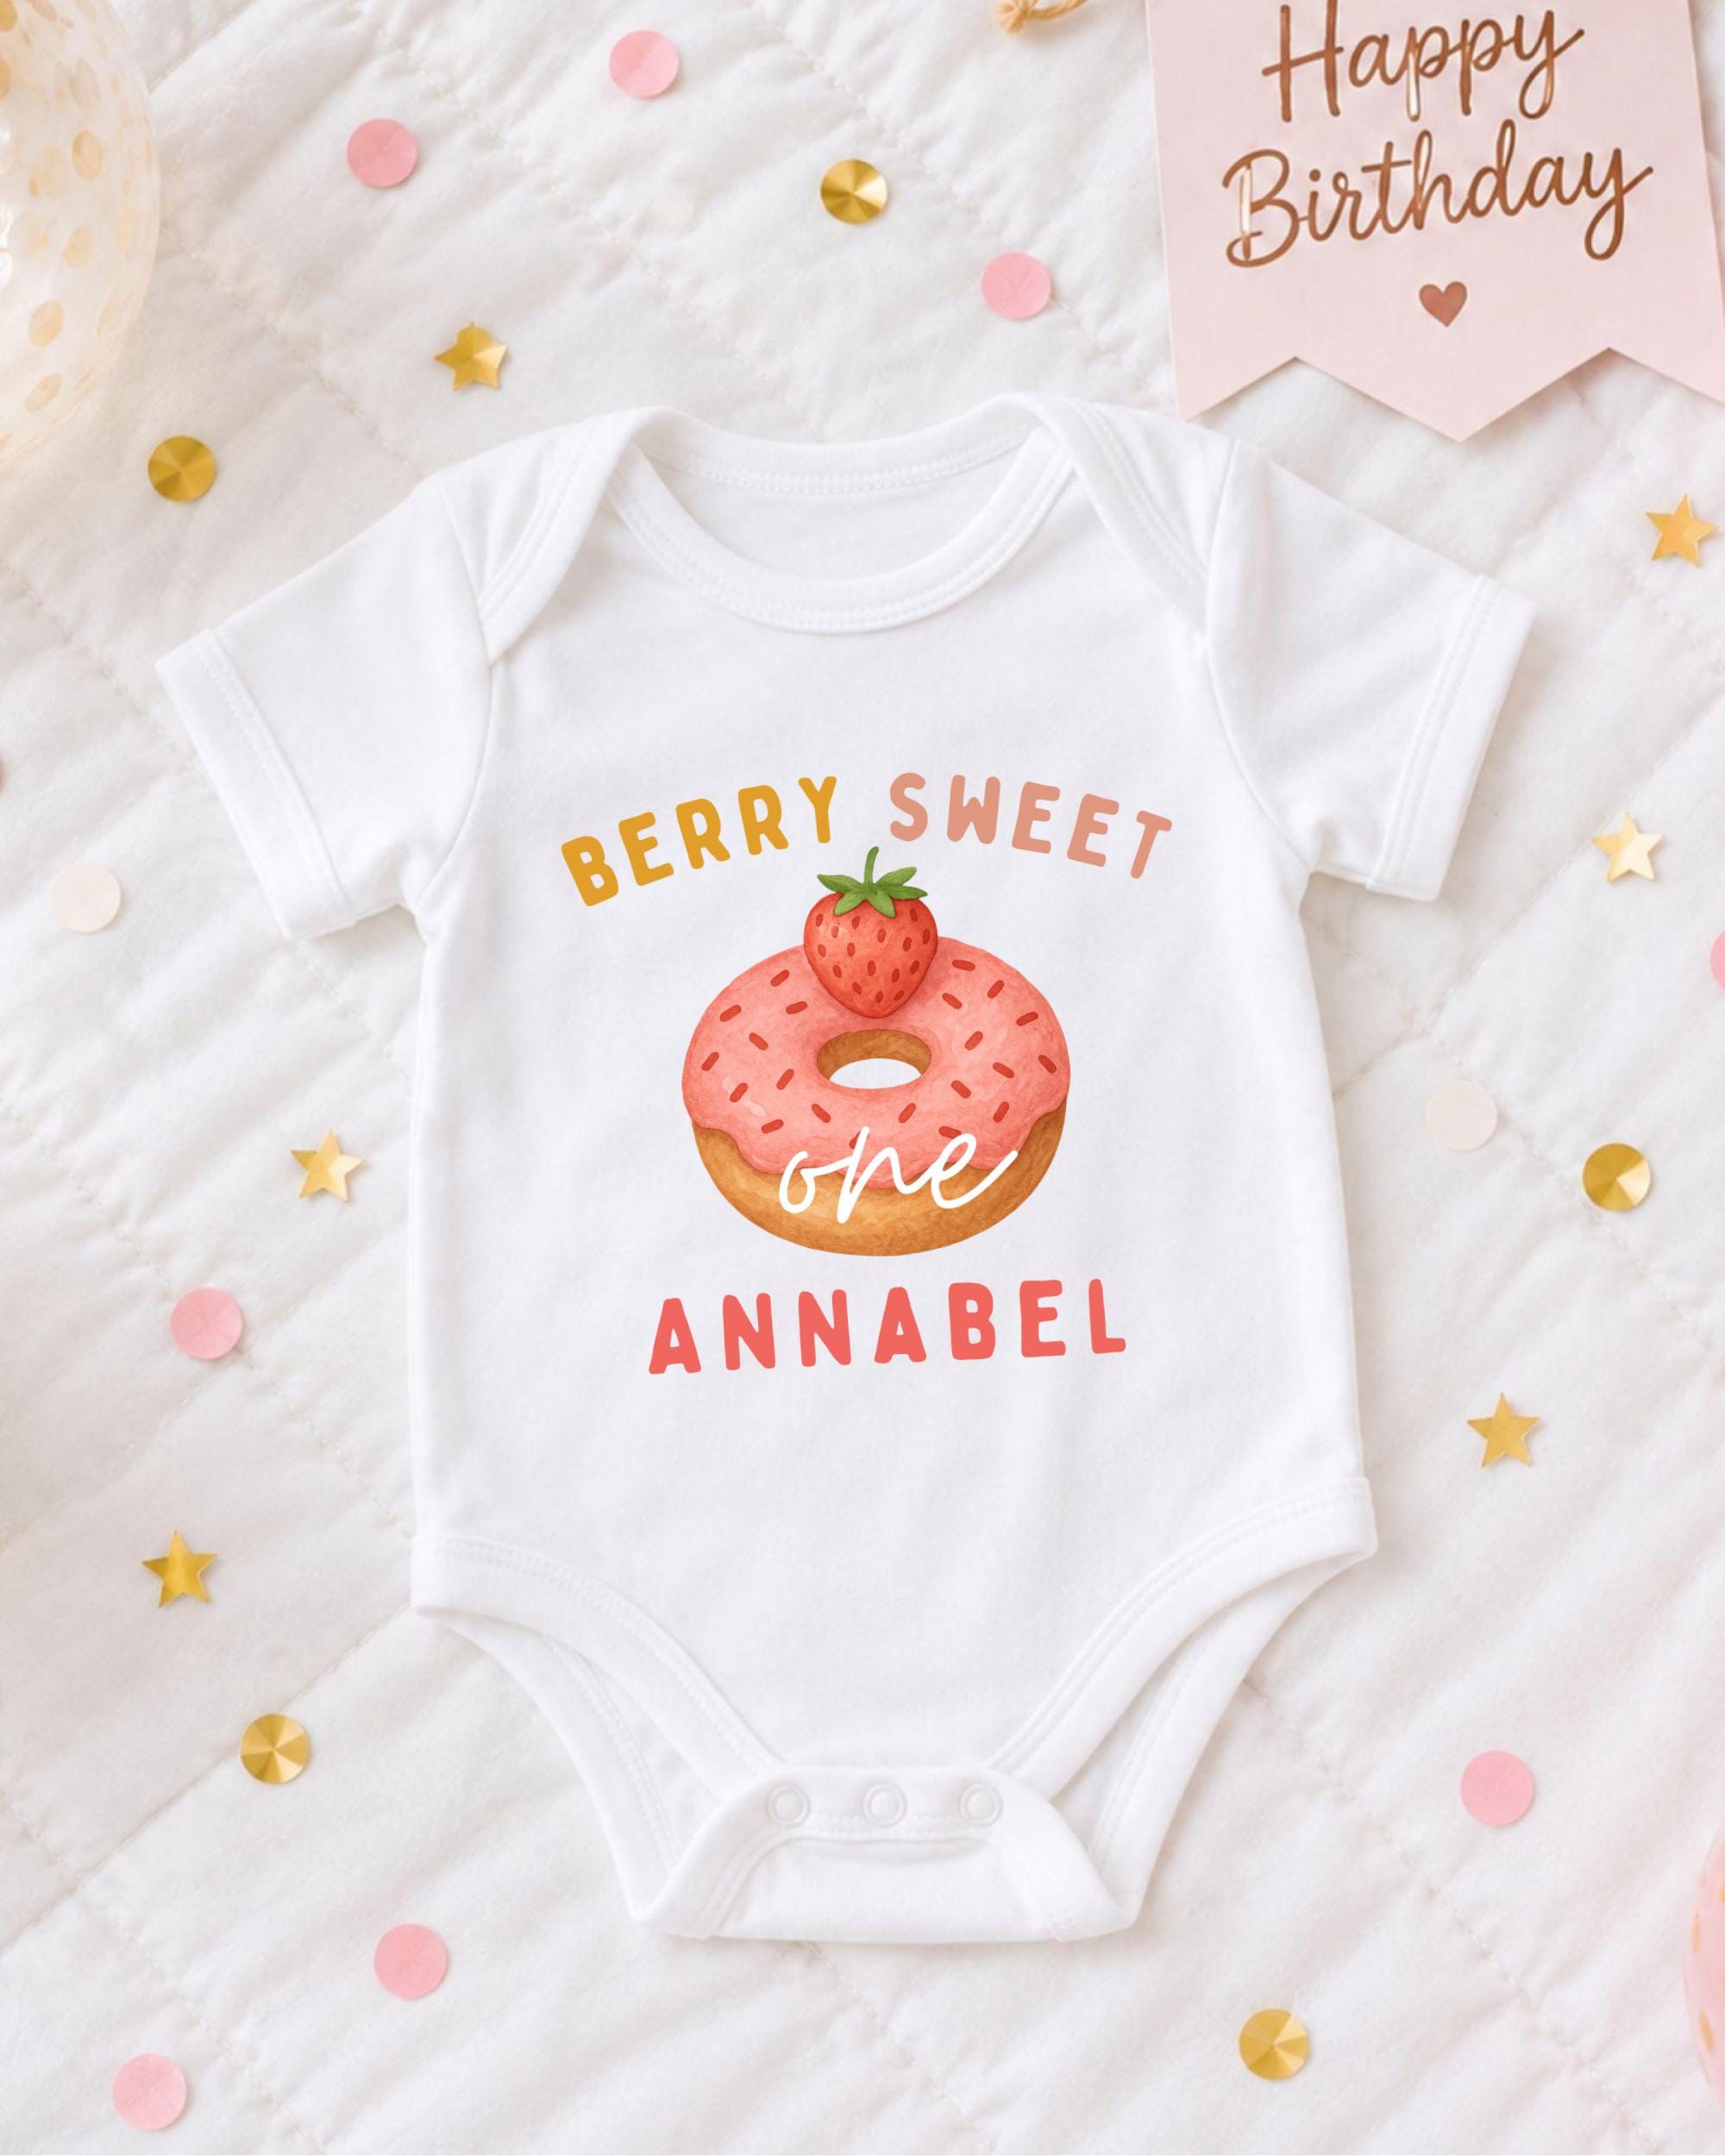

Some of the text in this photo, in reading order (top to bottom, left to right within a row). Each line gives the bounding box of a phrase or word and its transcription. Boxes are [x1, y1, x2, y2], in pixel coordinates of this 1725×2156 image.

[1262, 0, 1584, 122] Happy
[1222, 118, 1653, 268] Birthday
[560, 772, 1173, 907] BERRY SWEET
[779, 1126, 1019, 1224] one
[648, 1278, 1127, 1375] ANNABEL
